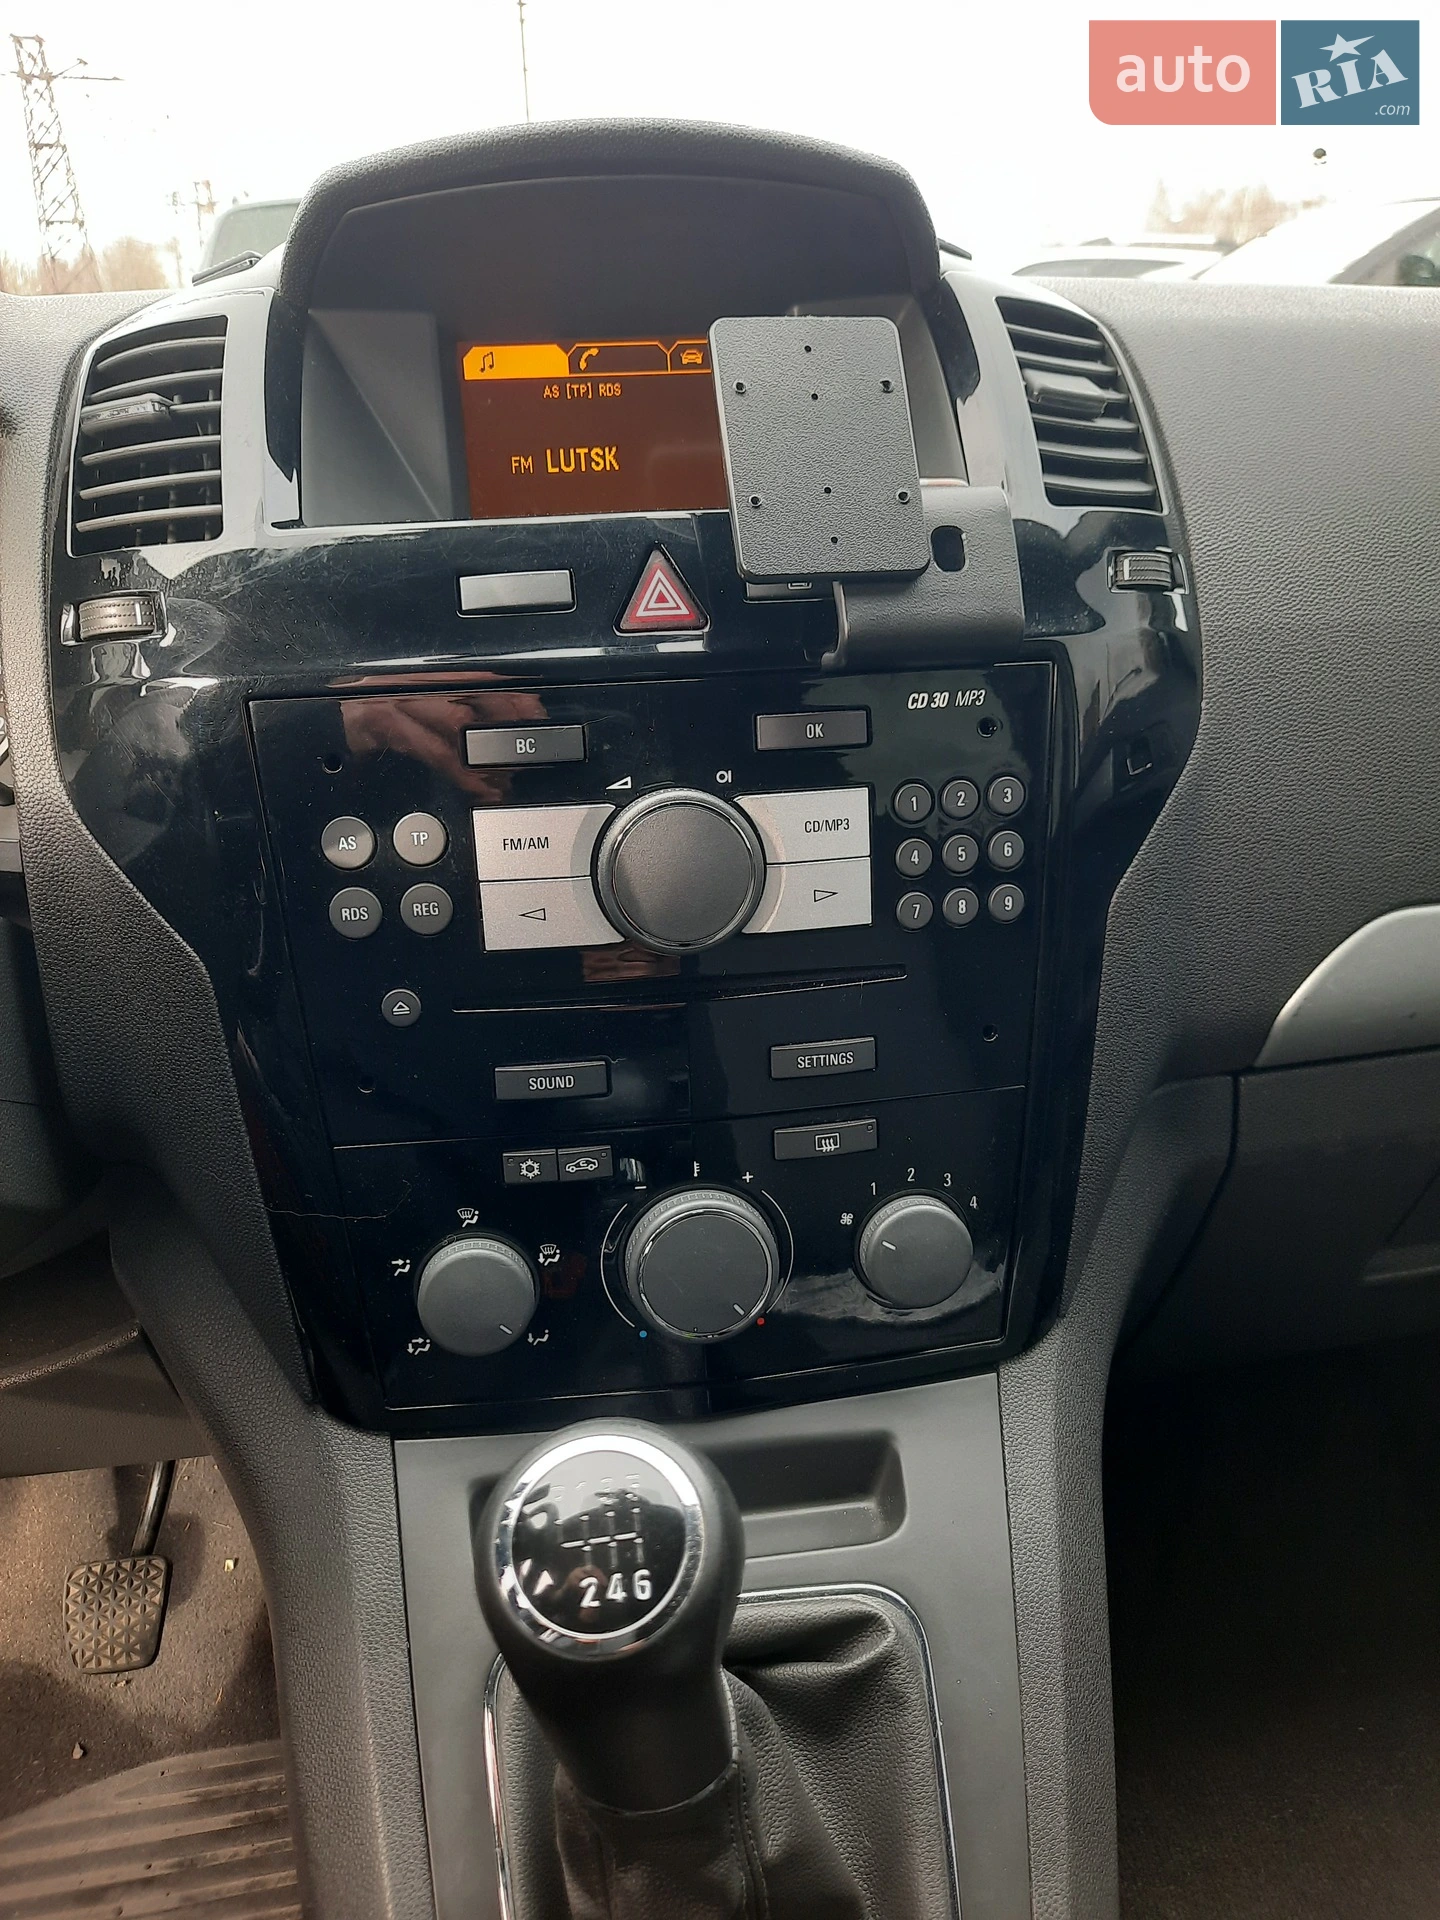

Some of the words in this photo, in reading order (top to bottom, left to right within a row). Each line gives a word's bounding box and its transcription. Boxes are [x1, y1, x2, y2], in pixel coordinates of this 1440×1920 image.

[543, 384, 560, 399] AS
[566, 382, 593, 399] [TP]
[598, 382, 622, 398] RDS
[511, 456, 534, 474] FM
[546, 446, 620, 474] LUTSK
[907, 692, 928, 710] CD
[931, 691, 949, 708] 30
[954, 689, 986, 707] MP3
[806, 723, 825, 739] OK
[515, 738, 537, 754] BC
[910, 797, 918, 811] 1
[956, 792, 966, 807] 2
[1003, 788, 1013, 803] 3
[805, 819, 849, 833] CD/MP3
[338, 836, 357, 851] AS
[411, 833, 429, 847] TP
[502, 836, 550, 851] FM/AM
[910, 850, 920, 865] 4
[957, 846, 967, 861] 5
[1003, 842, 1013, 857] 6
[341, 907, 369, 922] RDS
[412, 902, 440, 917] REG
[911, 904, 921, 919] 7
[957, 900, 967, 915] 8
[1004, 896, 1013, 911] 9
[797, 1051, 854, 1069] SETTINGS
[528, 1075, 575, 1091] SOUND
[870, 1182, 877, 1196] 1
[907, 1168, 916, 1183] 2
[943, 1172, 952, 1187] 3
[969, 1195, 978, 1210] 4
